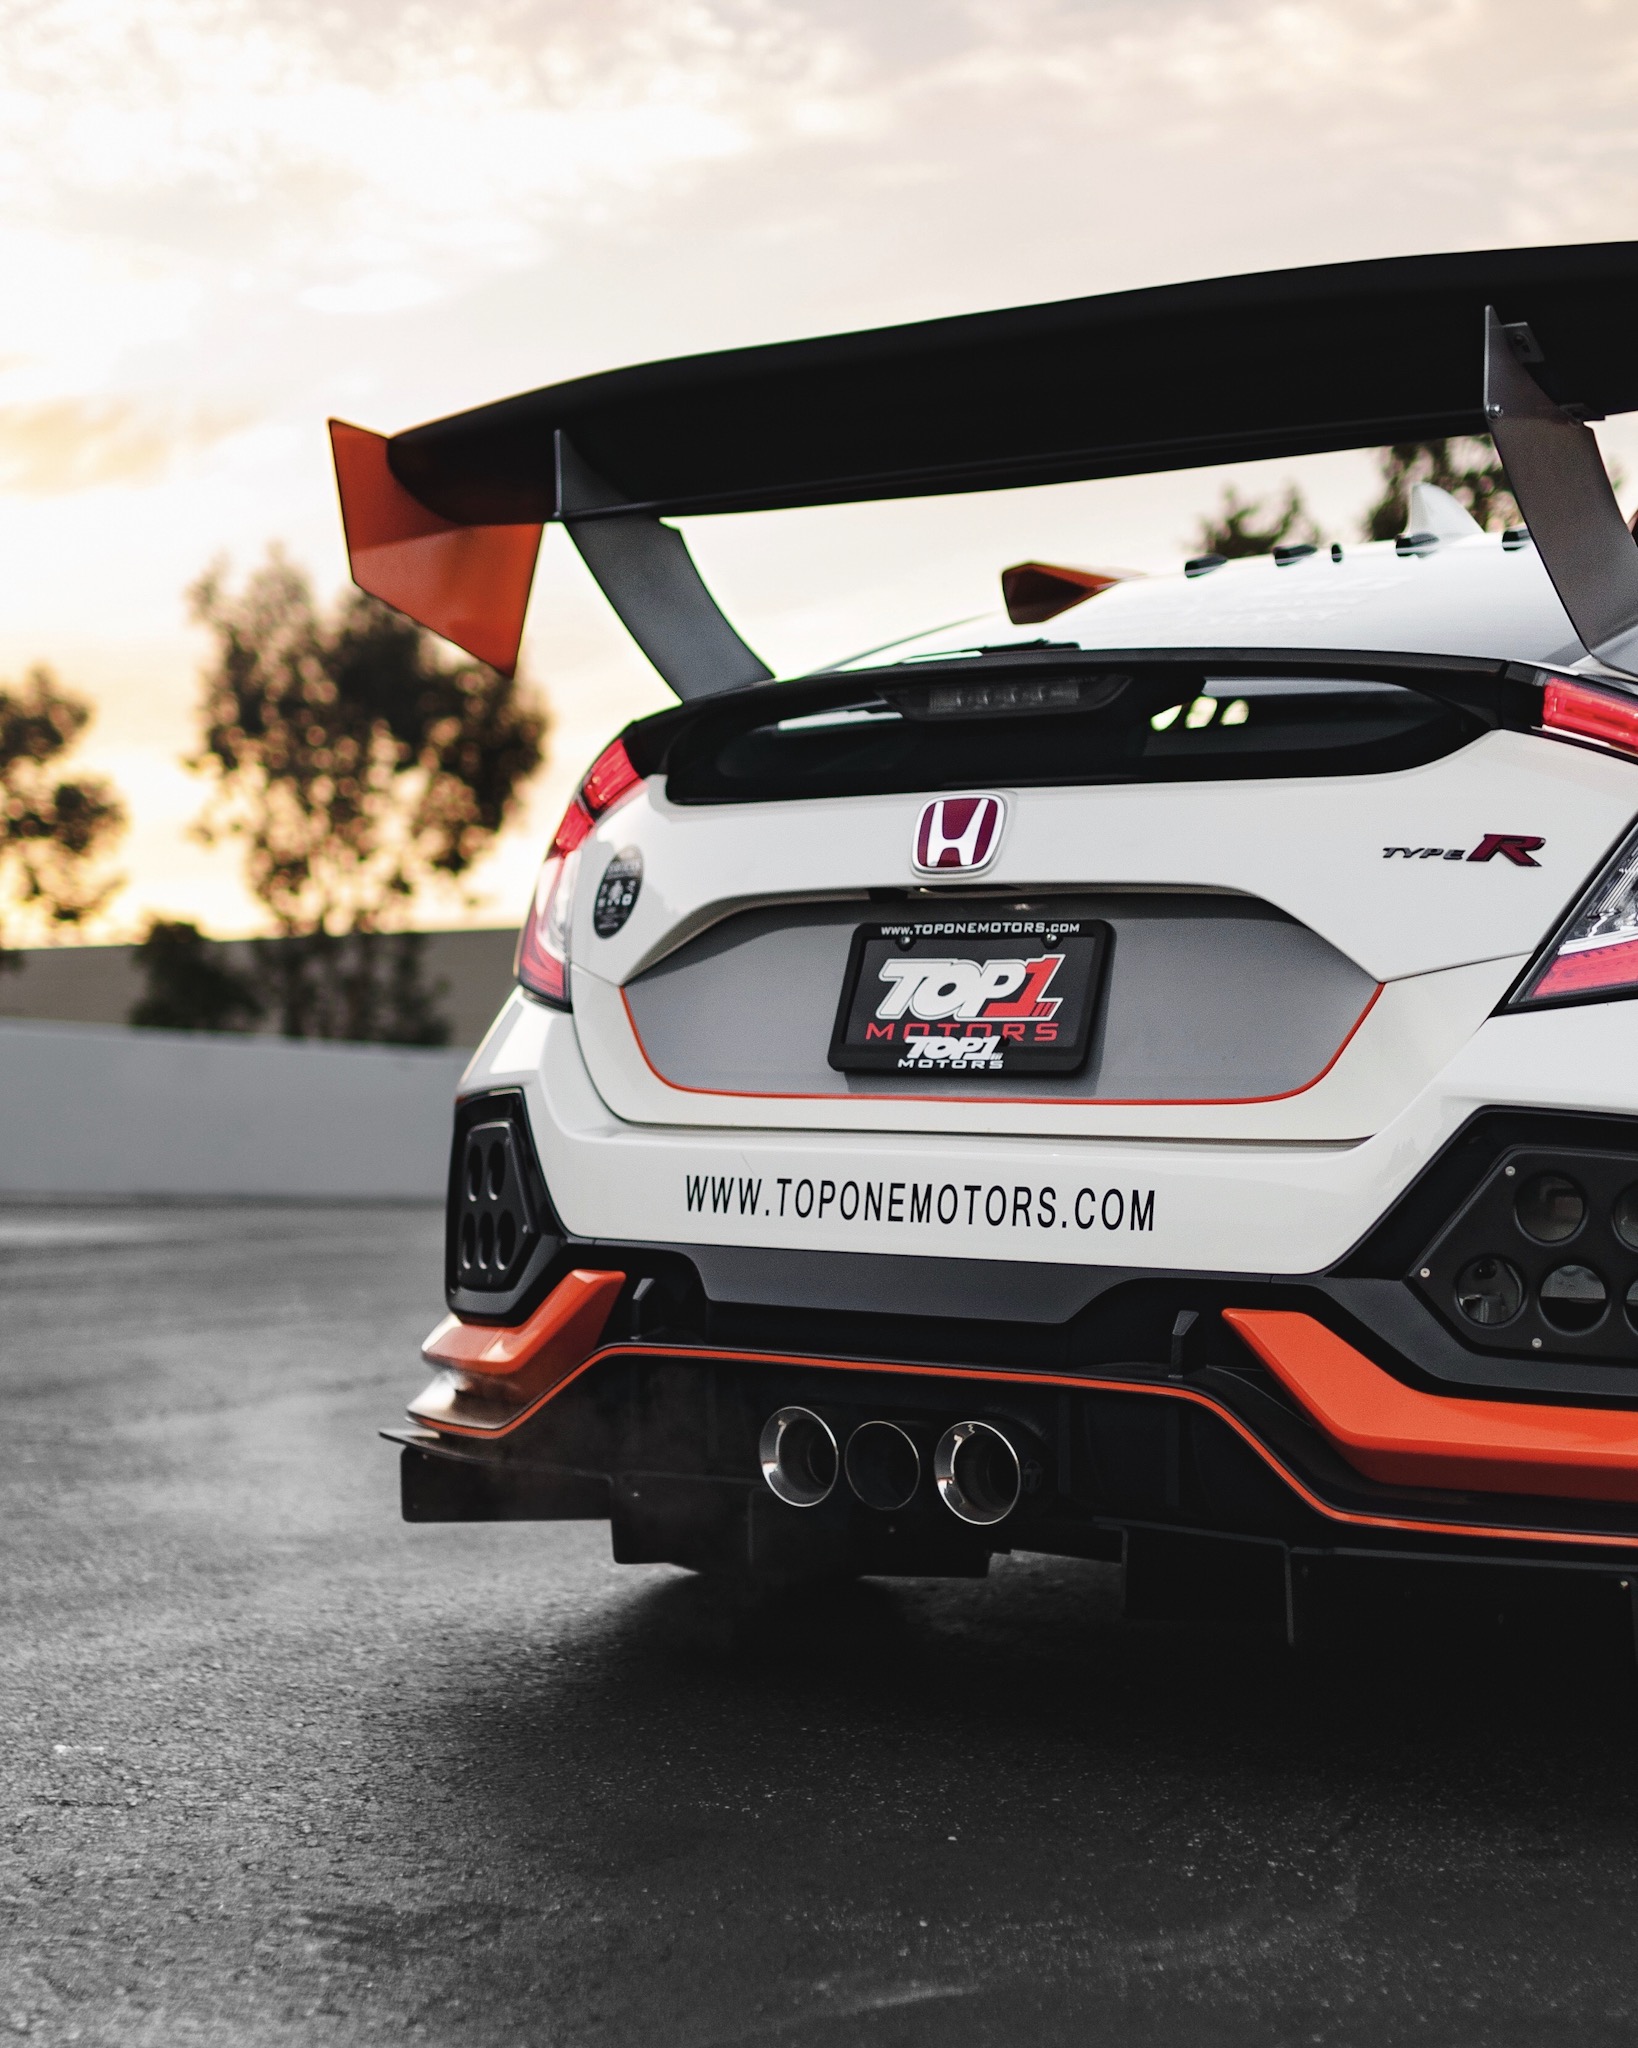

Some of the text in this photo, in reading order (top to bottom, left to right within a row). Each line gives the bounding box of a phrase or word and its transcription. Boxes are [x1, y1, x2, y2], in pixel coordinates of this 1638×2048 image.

[1382, 833, 1547, 867] TYPE R
[880, 922, 1081, 936] WWW.TOPONEMOTORS.COM
[875, 953, 1067, 1022] TOP1
[904, 1035, 1004, 1061] TOP1
[897, 1058, 1004, 1070] MOTORS
[685, 1174, 1157, 1232] WWW.TOPONEMOTORS.COM
